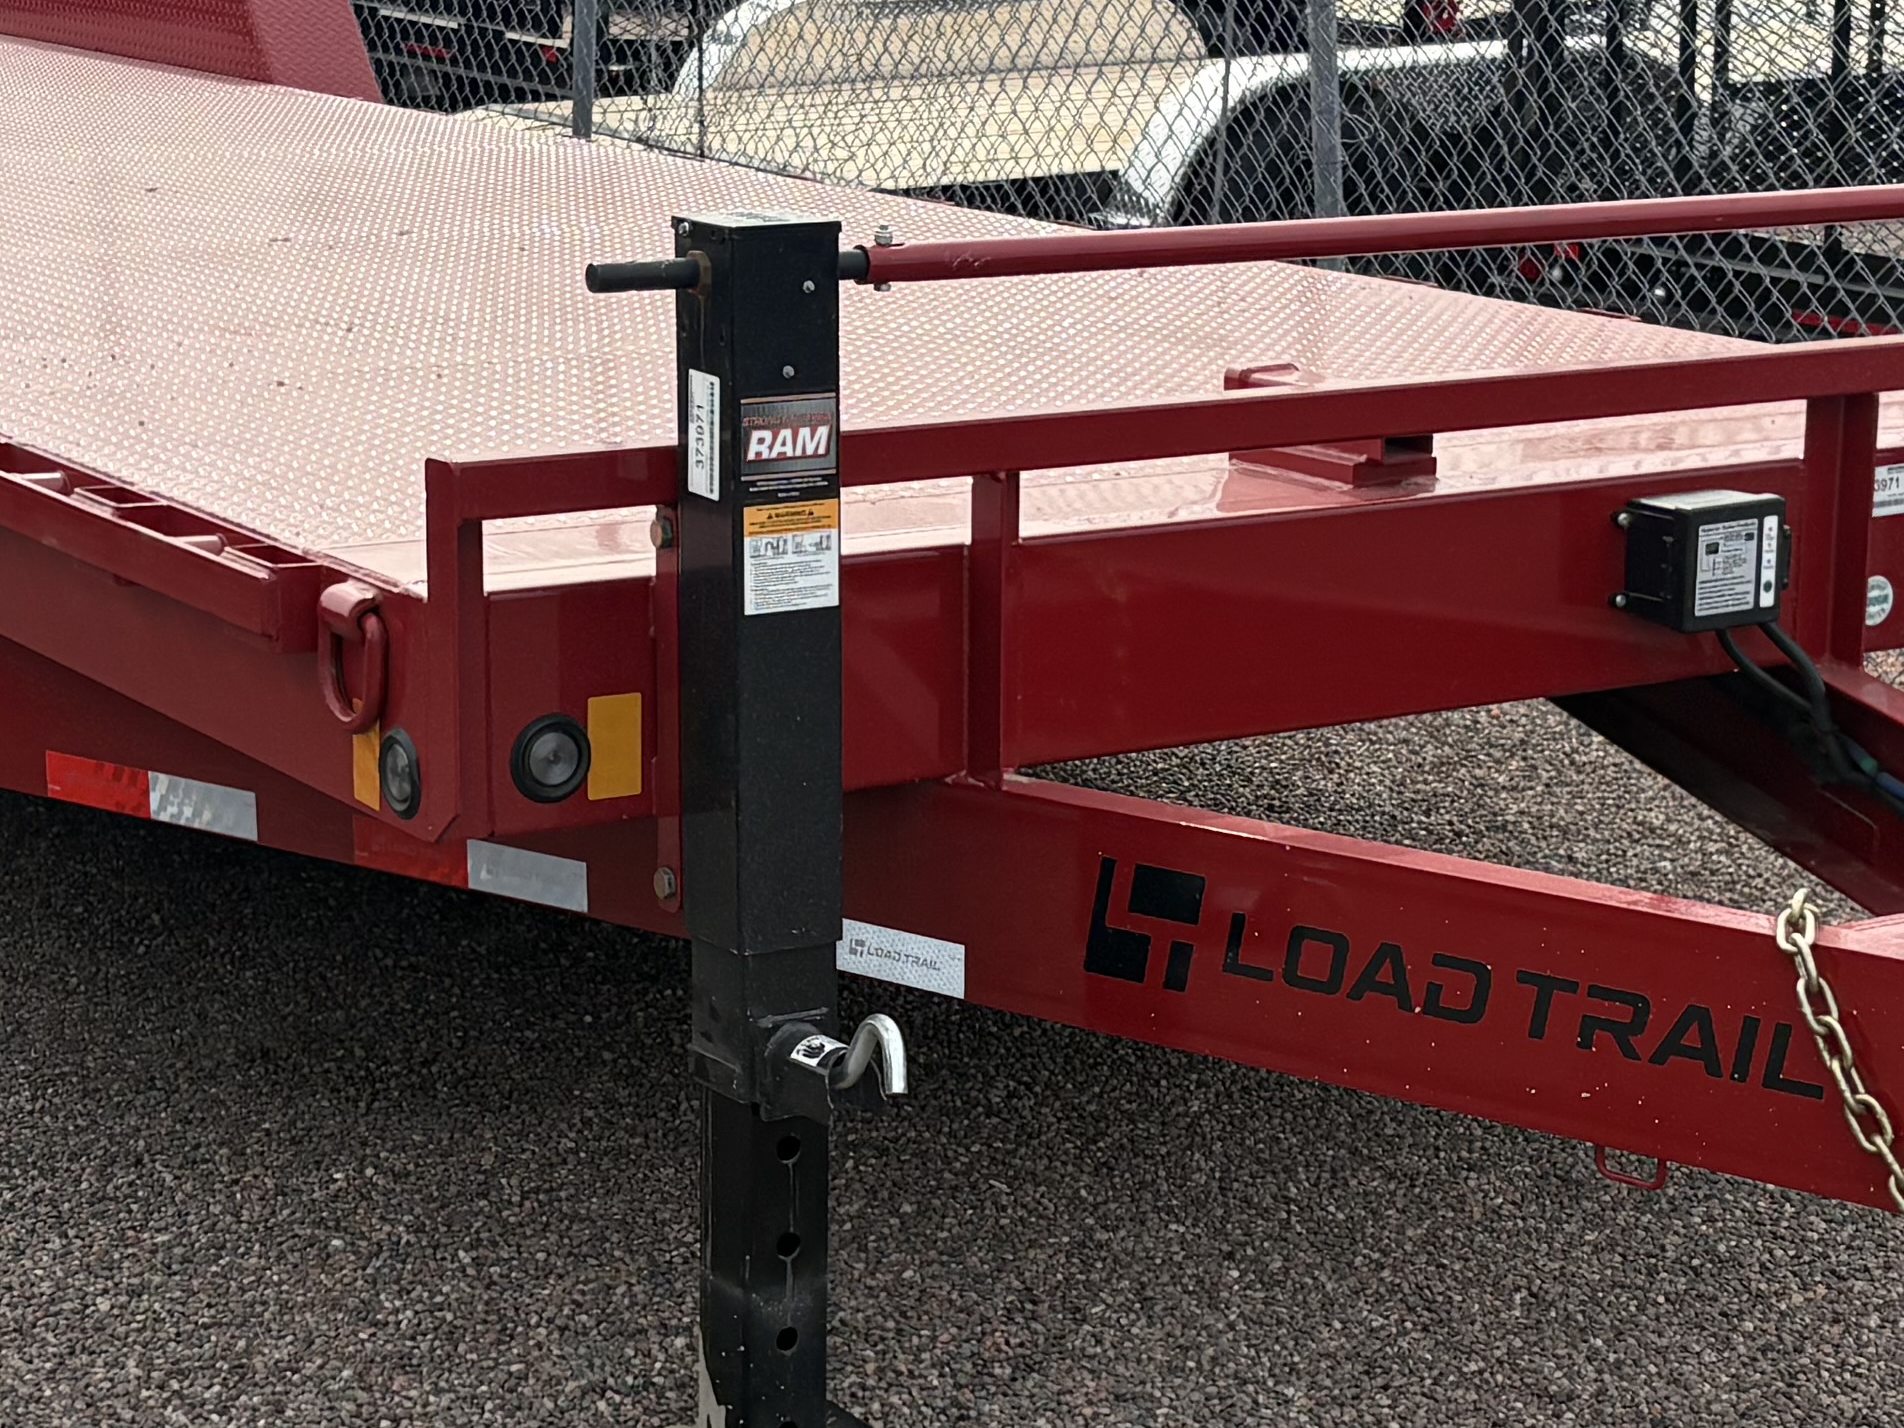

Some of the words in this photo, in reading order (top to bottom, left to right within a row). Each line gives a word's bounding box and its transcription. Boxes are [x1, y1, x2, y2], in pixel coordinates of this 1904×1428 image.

[747, 424, 831, 462] RAM
[866, 943, 902, 963] LOAD
[903, 953, 941, 971] TRAIL
[1221, 911, 1492, 1025] LOAD
[1515, 968, 1825, 1101] TRAIL
